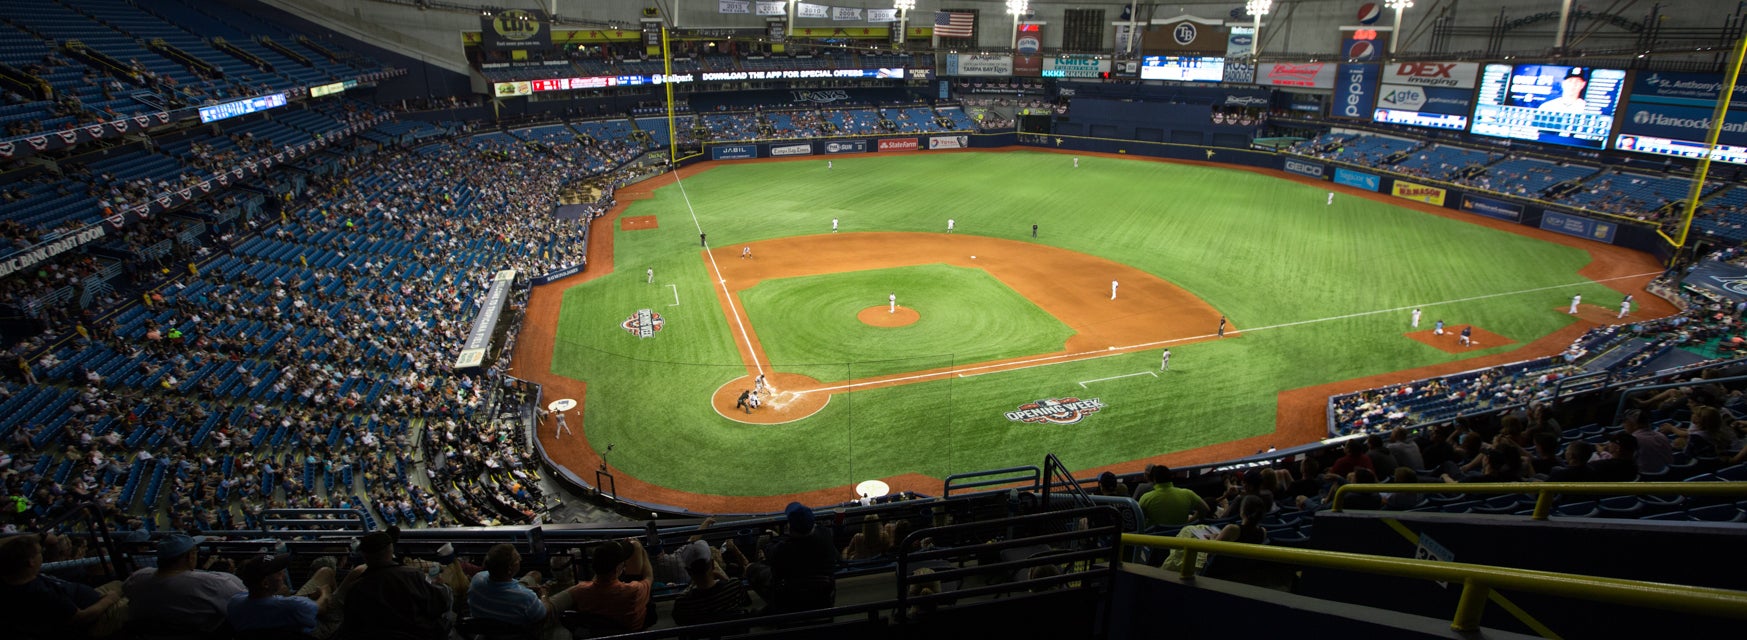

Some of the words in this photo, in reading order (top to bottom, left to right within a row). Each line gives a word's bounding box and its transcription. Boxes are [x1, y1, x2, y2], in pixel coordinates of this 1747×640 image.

[1177, 26, 1193, 41] TB
[702, 72, 748, 80] DOWNLOAD
[748, 72, 765, 80] THE
[1396, 62, 1457, 78] DEX
[1407, 76, 1460, 87] imaging
[1346, 68, 1365, 117] pepsi
[1397, 90, 1420, 102] gte
[1648, 112, 1711, 130] Hancock
[1286, 160, 1322, 176] GEICO
[22, 248, 49, 267] BANK
[47, 236, 78, 256] DRAFT
[78, 226, 105, 245] ROOM
[1005, 405, 1066, 420] OPENING
[1064, 399, 1101, 410] WEEK
